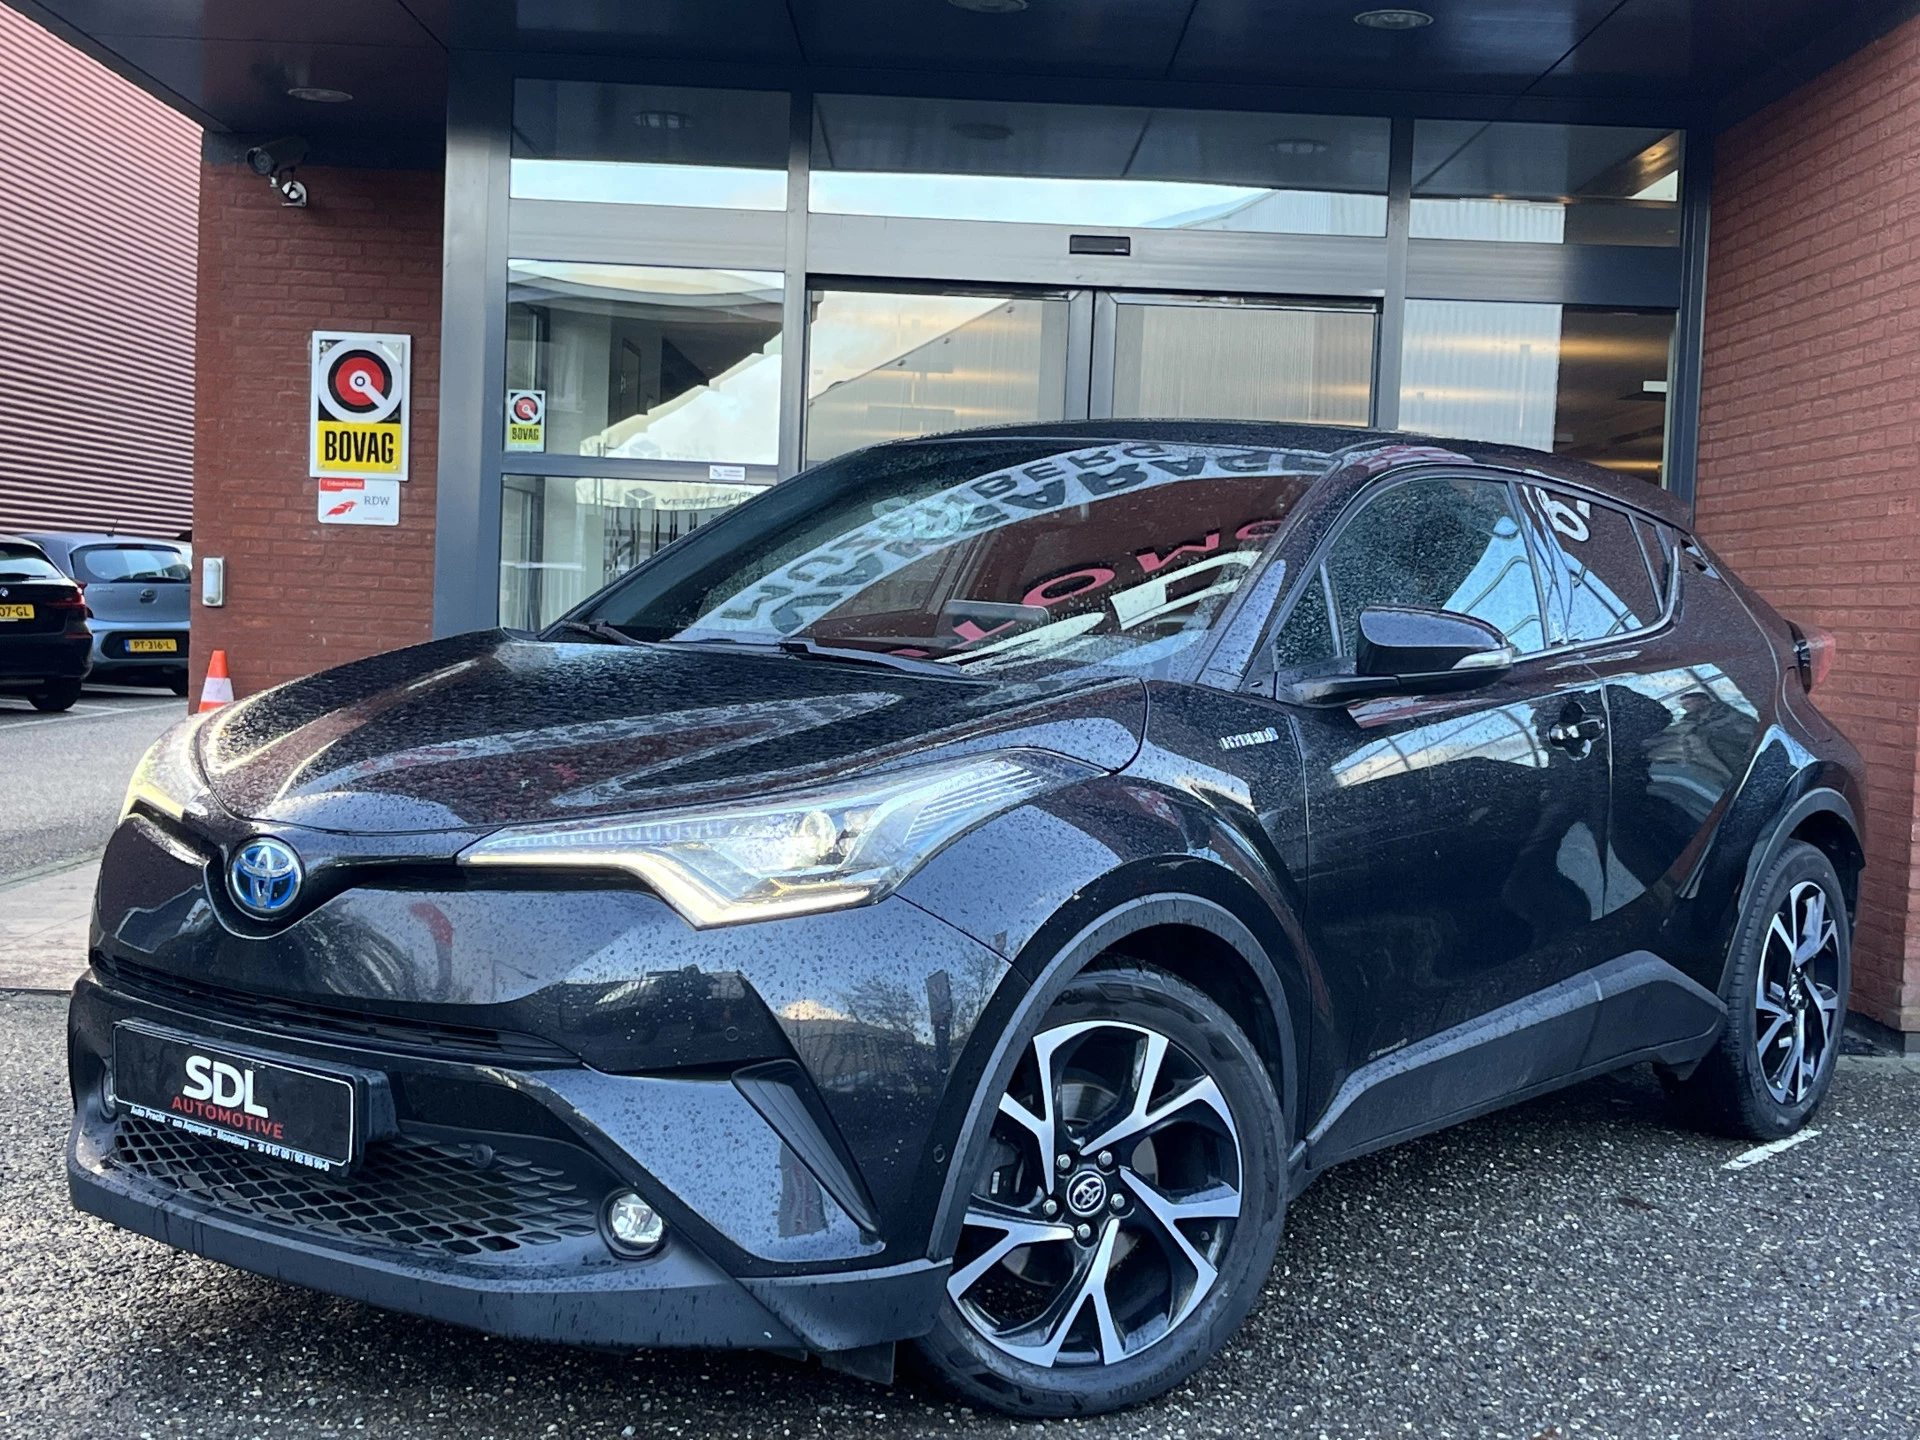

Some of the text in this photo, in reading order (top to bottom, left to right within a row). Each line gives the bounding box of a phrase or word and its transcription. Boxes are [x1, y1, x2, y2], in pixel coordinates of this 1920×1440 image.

[324, 430, 394, 464] BOVAG
[511, 427, 539, 441] BOVAG
[363, 495, 390, 506] RDW
[182, 1055, 269, 1119] SDL
[172, 1095, 284, 1139] AUTOMOTIVE
